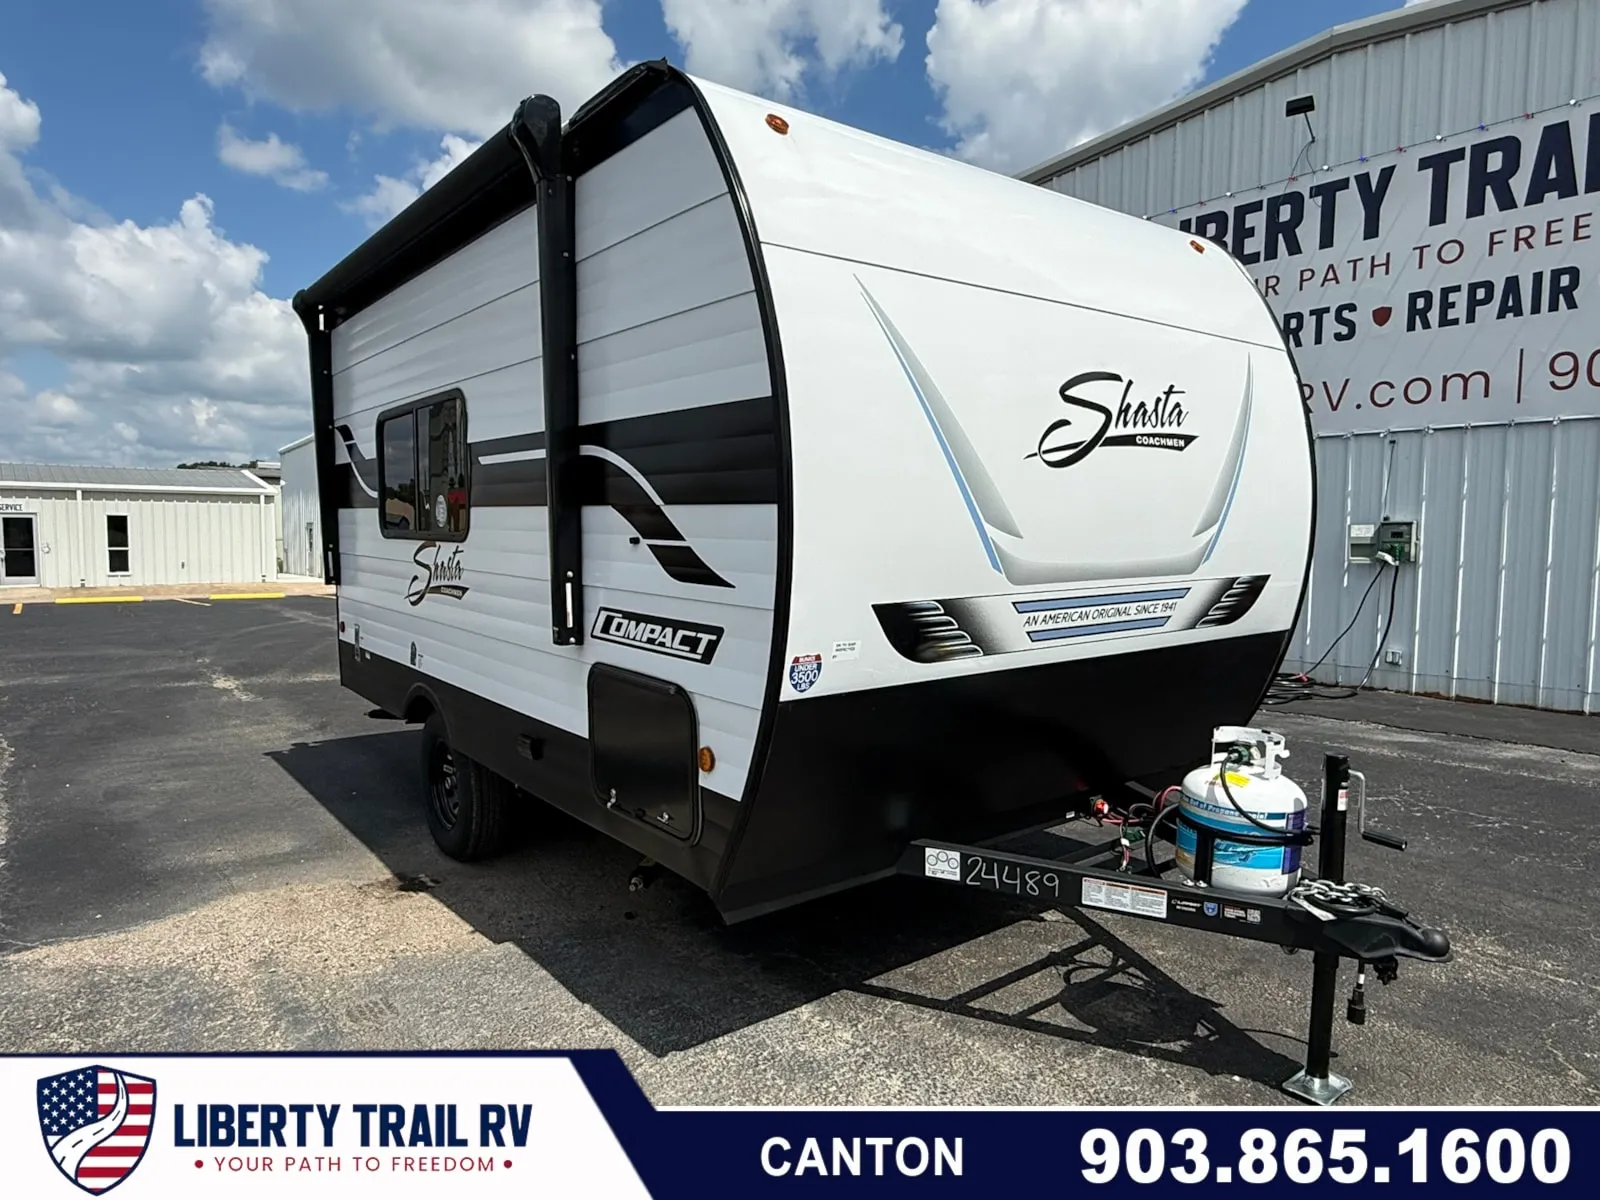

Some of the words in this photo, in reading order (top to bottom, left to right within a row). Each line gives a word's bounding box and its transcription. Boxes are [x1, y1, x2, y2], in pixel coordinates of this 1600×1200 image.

[1180, 164, 1397, 266] BERTY
[1298, 252, 1391, 292] PATH
[1412, 239, 1465, 270] TO
[1488, 212, 1593, 257] FREE
[1406, 265, 1580, 332] REPAIR
[1038, 371, 1190, 469] Shasta
[1135, 435, 1185, 447] COACHMEN
[408, 540, 465, 606] Shasta
[592, 610, 718, 660] COMPACT
[1023, 615, 1040, 627] AN
[1040, 609, 1092, 626] AMERICAN
[1091, 605, 1132, 620] ORIGINAL
[1133, 602, 1159, 616] SINCE
[1160, 601, 1178, 613] 1941
[791, 670, 819, 684] 3500
[795, 664, 817, 672] UNDER
[966, 856, 1060, 898] 24489
